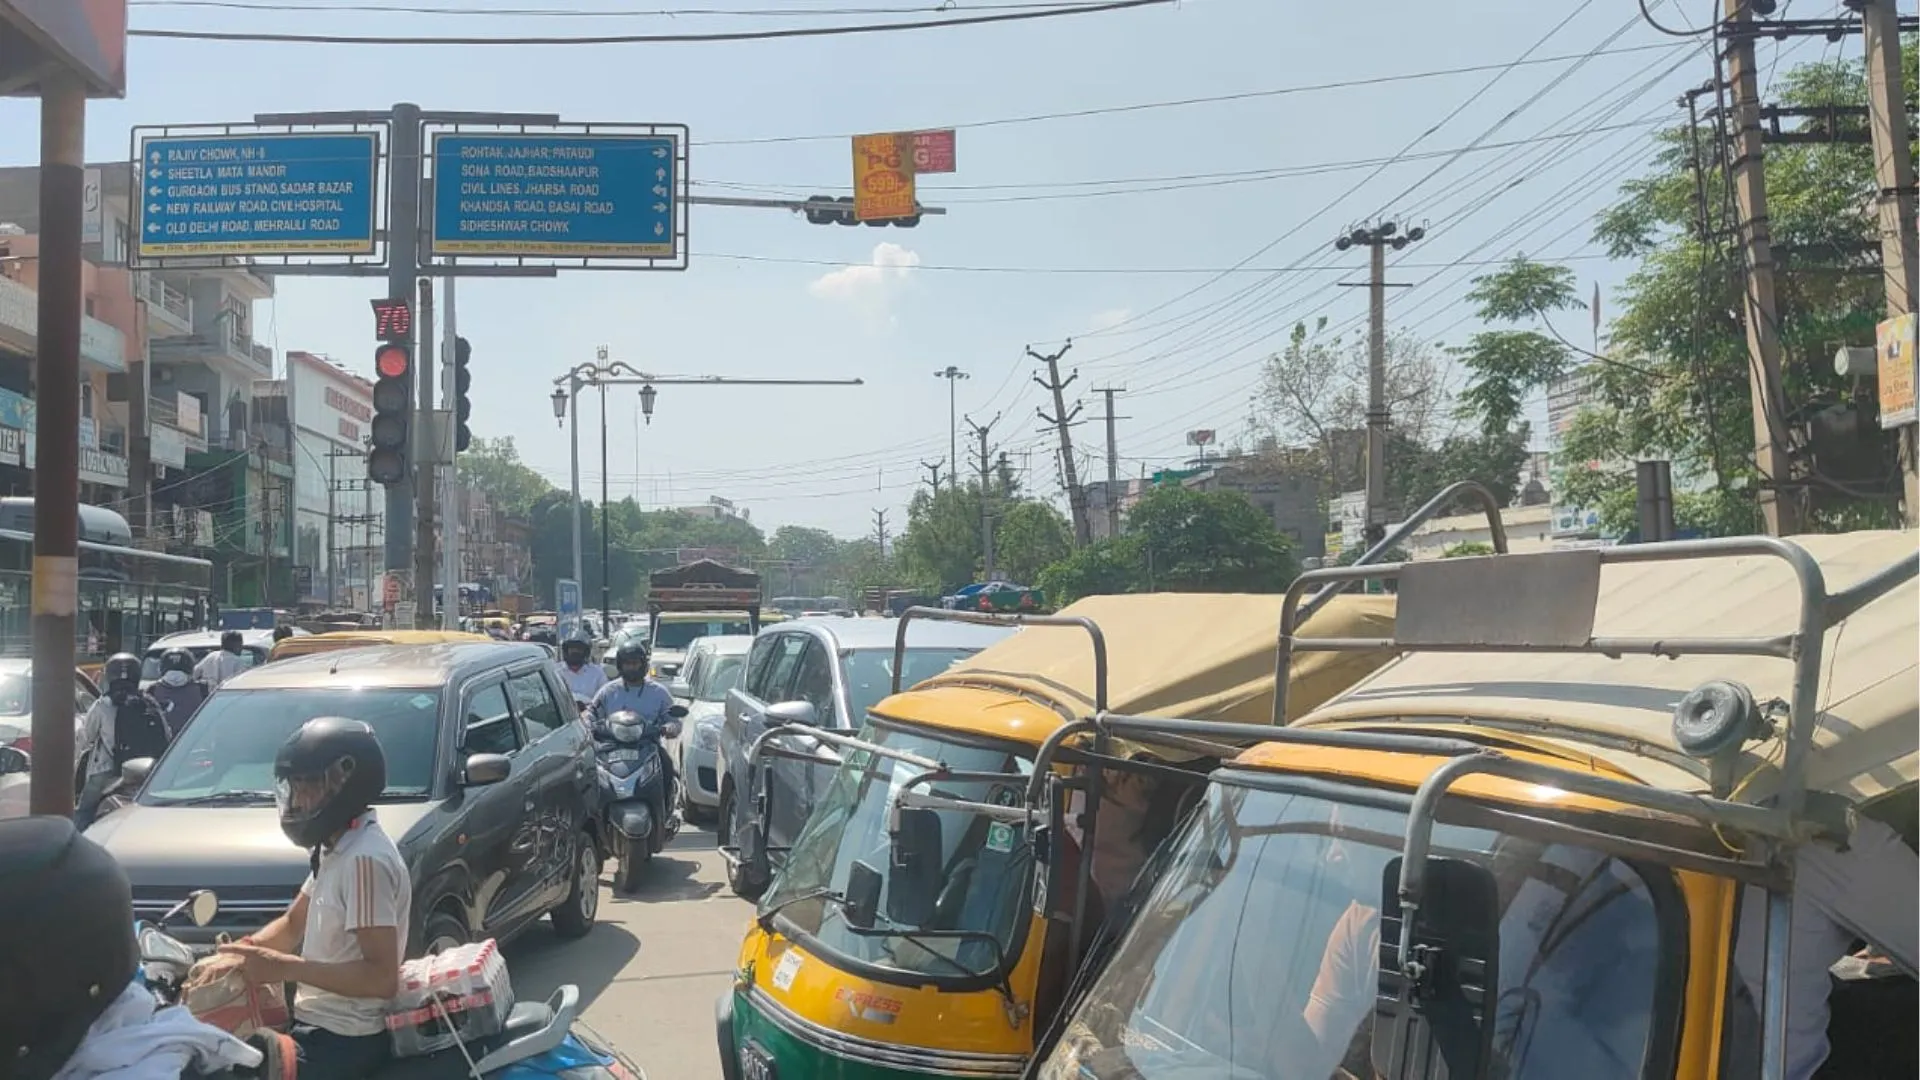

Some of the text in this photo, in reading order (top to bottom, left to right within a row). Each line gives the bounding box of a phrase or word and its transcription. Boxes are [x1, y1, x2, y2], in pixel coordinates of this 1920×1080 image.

[168, 149, 198, 161] RAJIV
[553, 147, 595, 159] PATAUDI
[168, 165, 287, 180] SHEETLA MATA MANDIR
[462, 164, 490, 176] SONA
[168, 184, 218, 197] GURGAON
[221, 184, 242, 196] BUS
[280, 182, 315, 194] SADAR
[318, 182, 353, 194] BAZAR
[461, 182, 487, 194] CIVIL
[525, 183, 566, 195] JHARSA
[570, 183, 600, 196] ROAD
[166, 202, 191, 215] NEW
[193, 201, 236, 214] RAILWAY
[295, 199, 344, 212] HOSPITAL
[460, 200, 510, 213] KHANDSA
[548, 200, 580, 213] BASAI
[584, 201, 614, 214] ROAD
[167, 221, 187, 234] OLD
[190, 221, 219, 234] DELHI
[254, 219, 306, 232] MEHRAULI
[310, 218, 340, 231] ROAD
[460, 220, 569, 233] SIDHESHWAR CHOWK
[376, 305, 409, 335] 70
